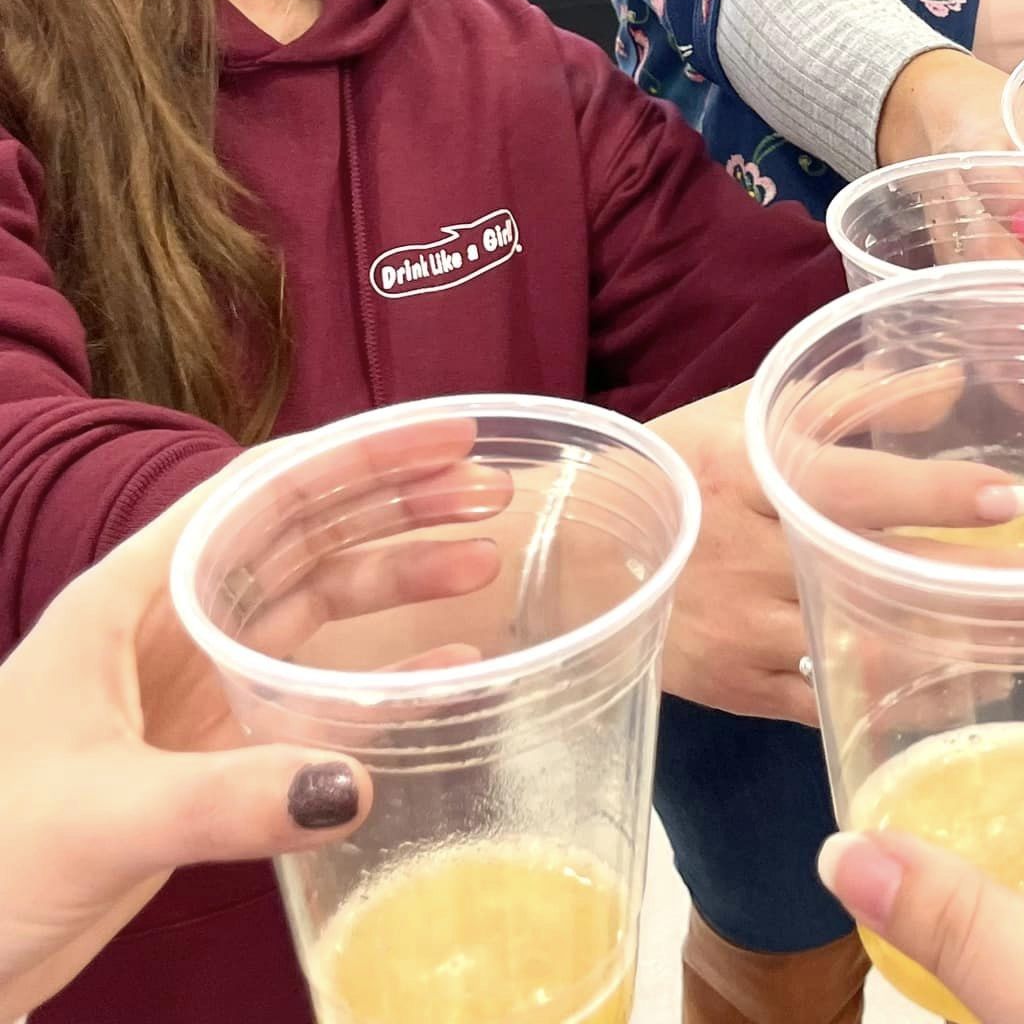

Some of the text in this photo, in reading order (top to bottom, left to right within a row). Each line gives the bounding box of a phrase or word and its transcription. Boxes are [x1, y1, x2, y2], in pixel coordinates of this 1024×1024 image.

[381, 254, 430, 290] Drink
[429, 249, 463, 276] Like
[466, 244, 479, 262] a
